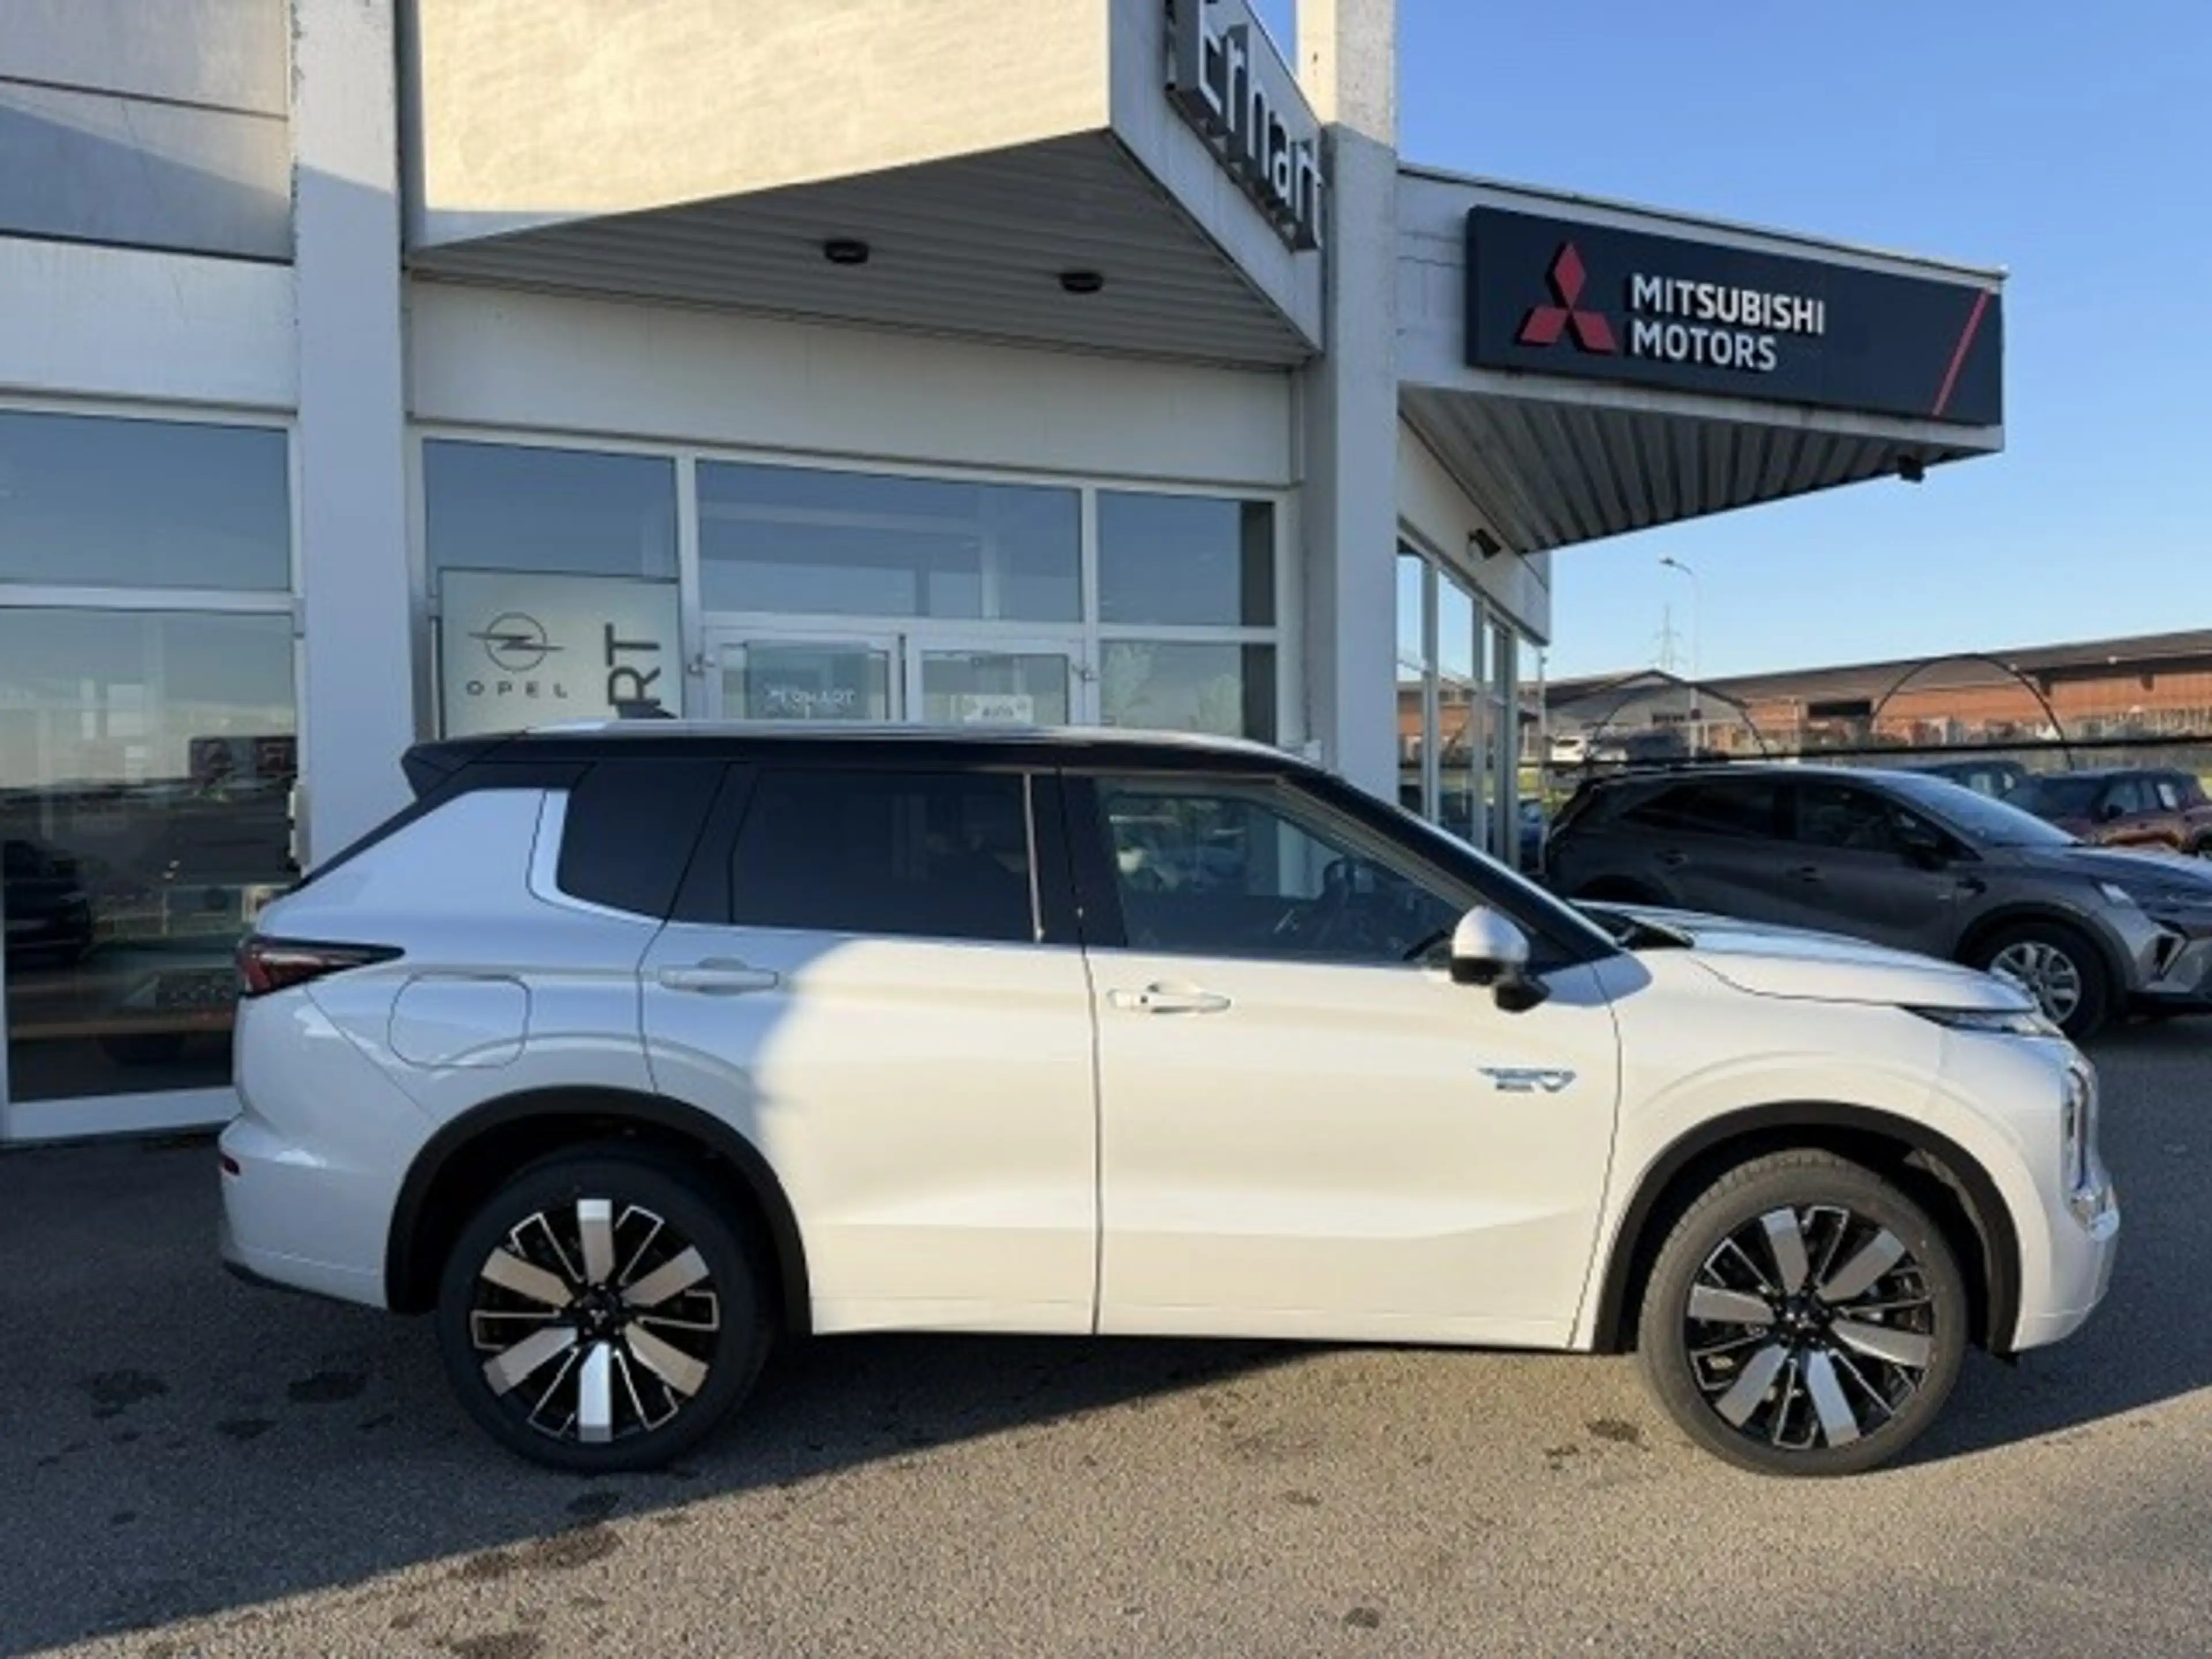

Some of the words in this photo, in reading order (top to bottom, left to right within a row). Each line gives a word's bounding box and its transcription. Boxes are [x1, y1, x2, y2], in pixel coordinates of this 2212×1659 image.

[1631, 274, 1825, 335] MITSUBISHI
[1631, 320, 1777, 372] MOTORS
[465, 680, 568, 699] OPEL
